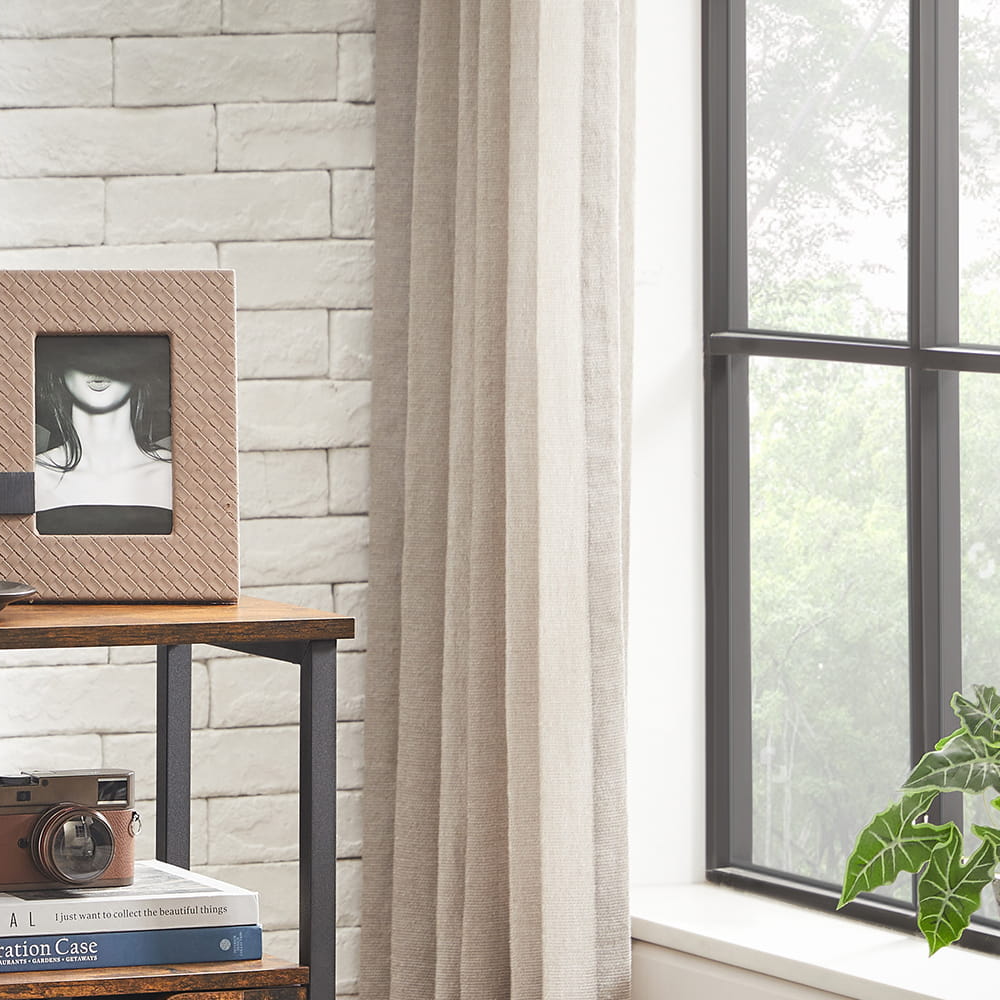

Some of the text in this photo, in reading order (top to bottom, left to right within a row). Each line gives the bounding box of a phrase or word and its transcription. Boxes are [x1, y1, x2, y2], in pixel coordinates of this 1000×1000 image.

[55, 904, 228, 924] I just want to collect the beautiful things
[55, 937, 98, 955] Case
[31, 956, 61, 964] GARDENS
[65, 954, 98, 963] GETAWAYS
